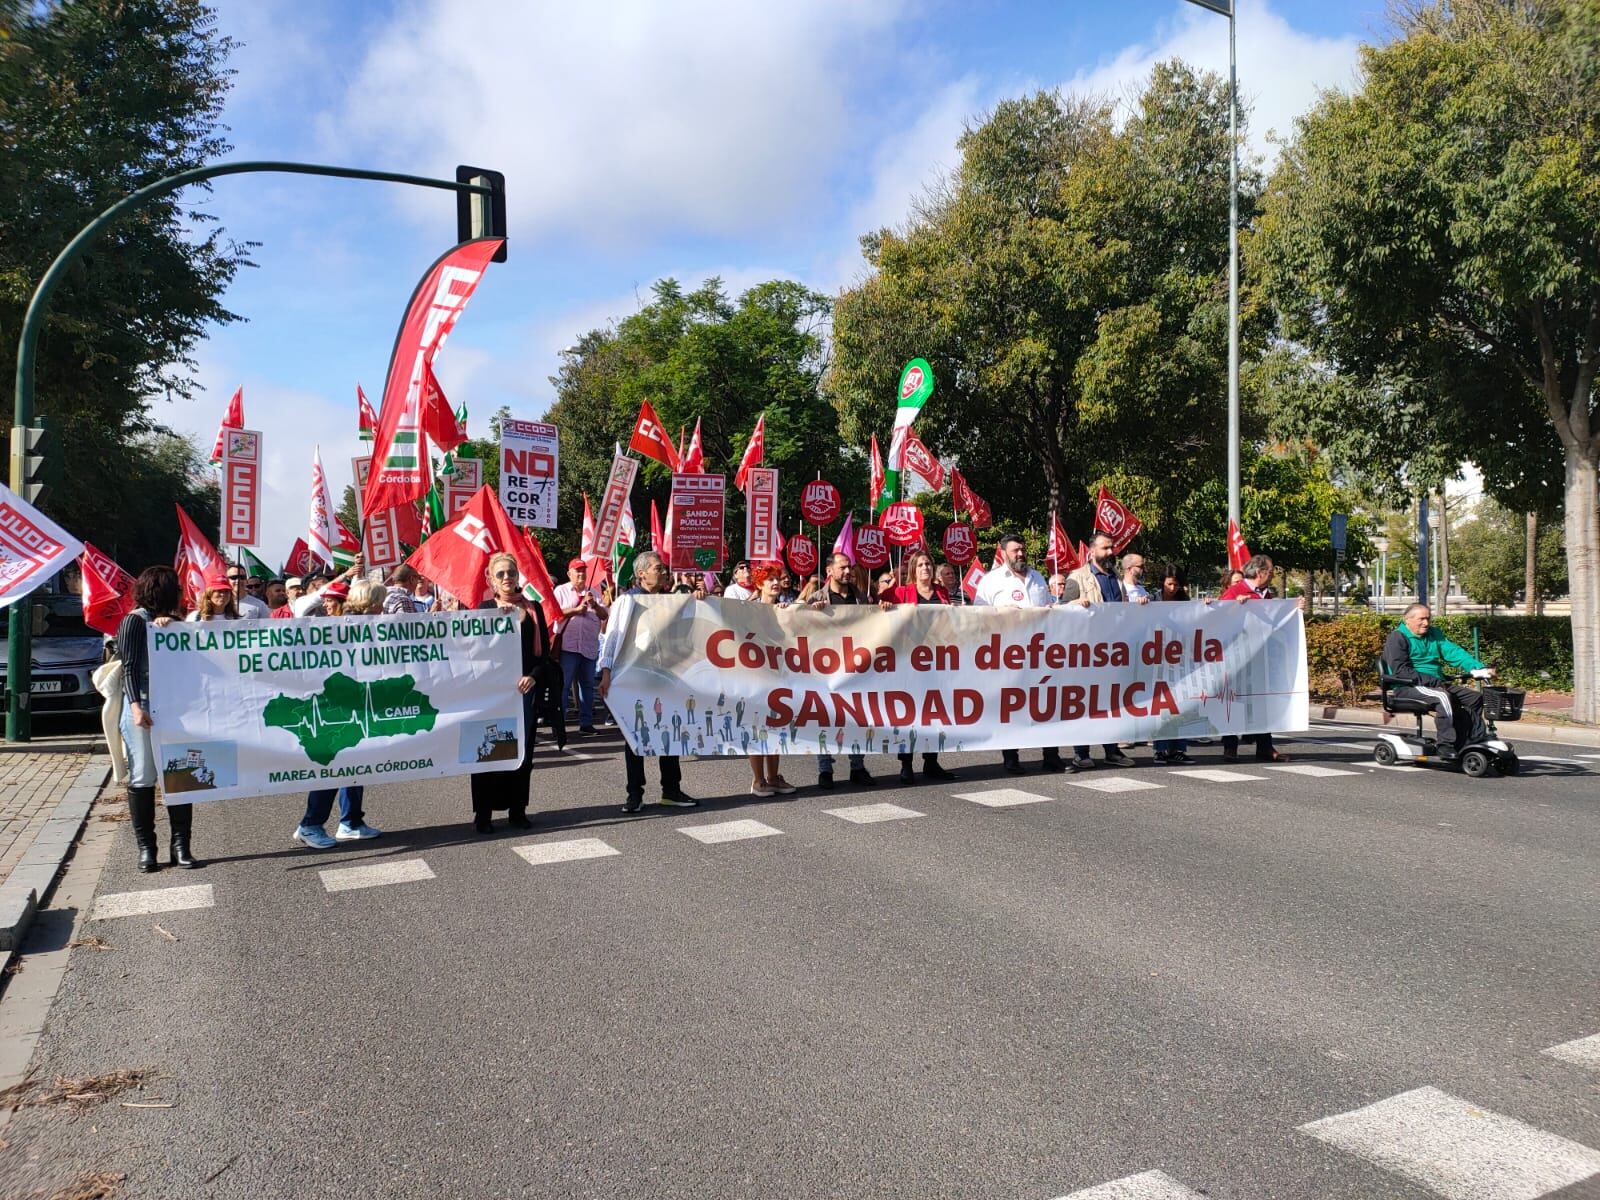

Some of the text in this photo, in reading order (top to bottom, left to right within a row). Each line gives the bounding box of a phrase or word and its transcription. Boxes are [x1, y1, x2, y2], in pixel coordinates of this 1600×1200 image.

[517, 423, 546, 434] CCOO
[638, 418, 666, 447] CC
[504, 448, 554, 478] NO
[379, 474, 421, 484] Córdoba
[508, 475, 528, 488] RE
[673, 477, 724, 490] CCOO
[507, 491, 540, 505] COR
[806, 485, 833, 502] UGT
[232, 467, 251, 539] CCOO
[507, 506, 537, 520] TES
[597, 489, 623, 552] CCOO
[886, 506, 917, 523] UGT
[1102, 502, 1122, 528] UGT
[680, 518, 711, 527] PÚBLICA
[754, 498, 769, 555] CCOO
[370, 512, 391, 560] COO
[858, 528, 885, 547] UGT
[947, 527, 970, 544] UGT
[792, 537, 812, 555] UGT
[155, 614, 515, 651] POR LA DEFENSA DE UNA SANIDAD PÚBLICA
[239, 643, 449, 673] DE CALIDAD Y UNIVERSAL
[706, 629, 1224, 675] Córdoba en defensa de la
[39, 681, 58, 691] KVY
[765, 675, 1180, 728] SANIDAD PÚBLICA
[384, 705, 420, 718] CAMB
[269, 757, 434, 783] MAREA BLANCA CÓRDOBA
